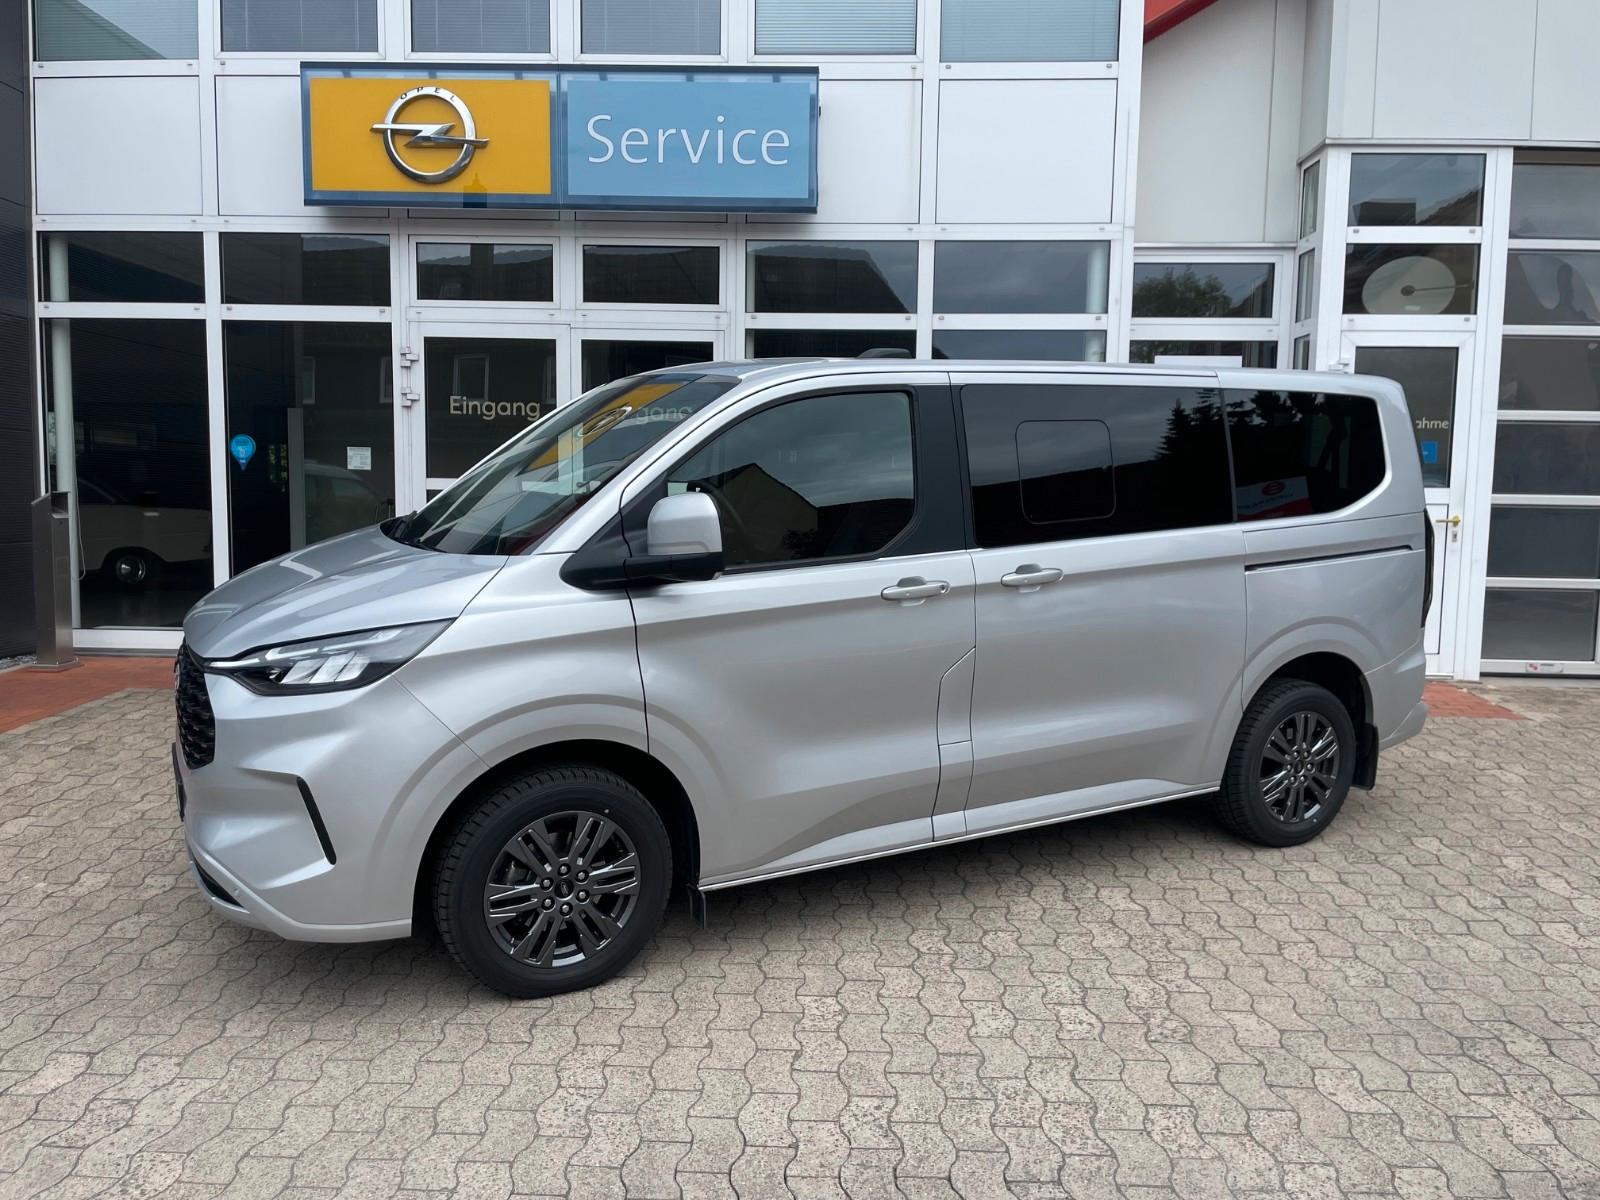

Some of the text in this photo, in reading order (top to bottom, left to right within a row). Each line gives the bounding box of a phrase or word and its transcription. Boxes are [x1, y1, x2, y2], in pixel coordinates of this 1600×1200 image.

[400, 86, 455, 101] OPEL
[587, 114, 790, 165] Service
[449, 395, 540, 421] Eingang
